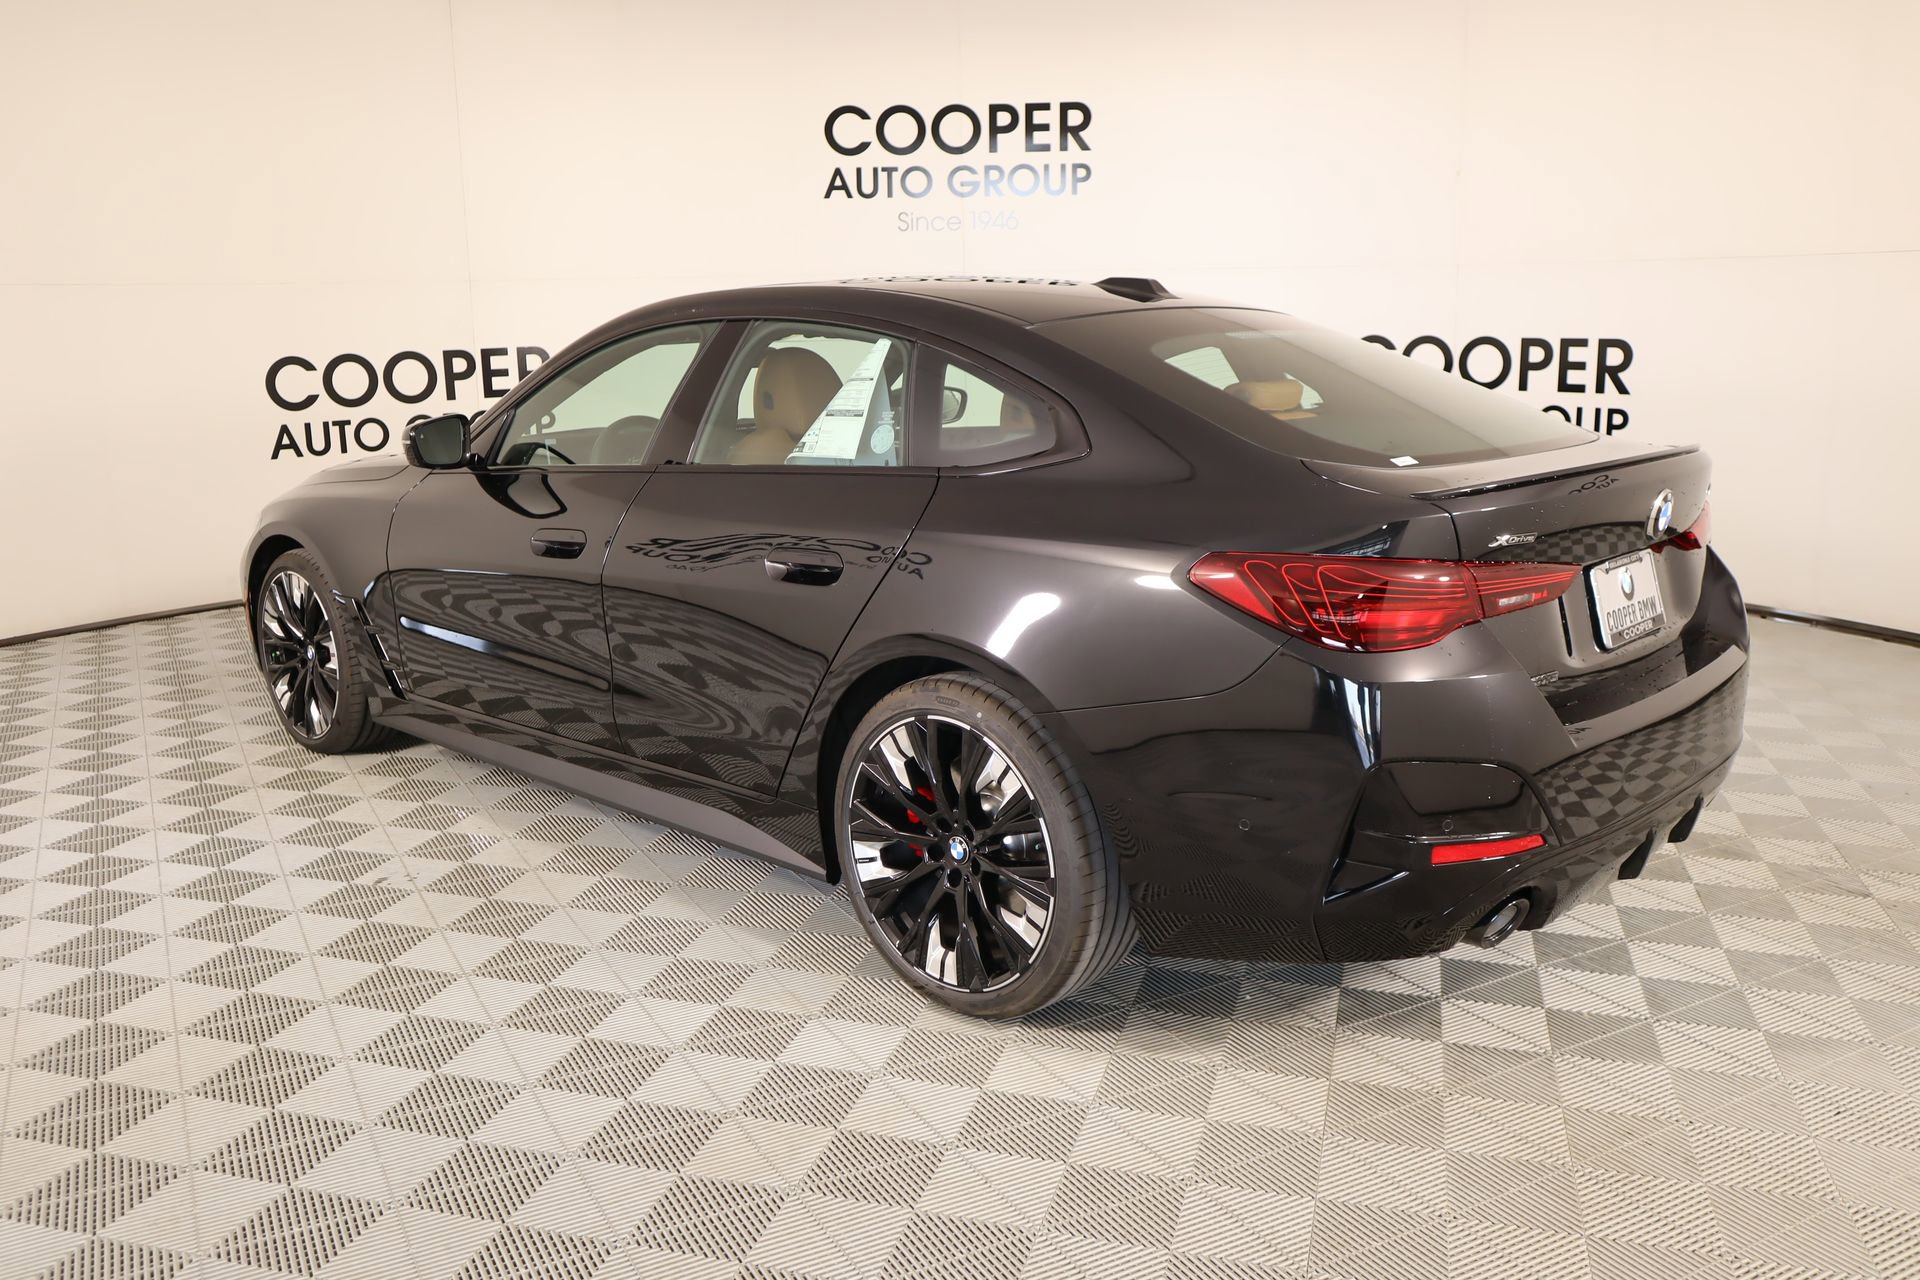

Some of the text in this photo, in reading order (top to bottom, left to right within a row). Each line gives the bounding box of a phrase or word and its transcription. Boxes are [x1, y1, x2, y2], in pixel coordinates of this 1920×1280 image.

[824, 102, 1092, 156] COOPER
[824, 163, 1092, 199] AUTO GROUP
[897, 210, 1019, 232] Since 1946
[271, 417, 390, 460] AUTO
[1606, 595, 1658, 632] COOPER BMW
[1623, 620, 1654, 640] COOPER
